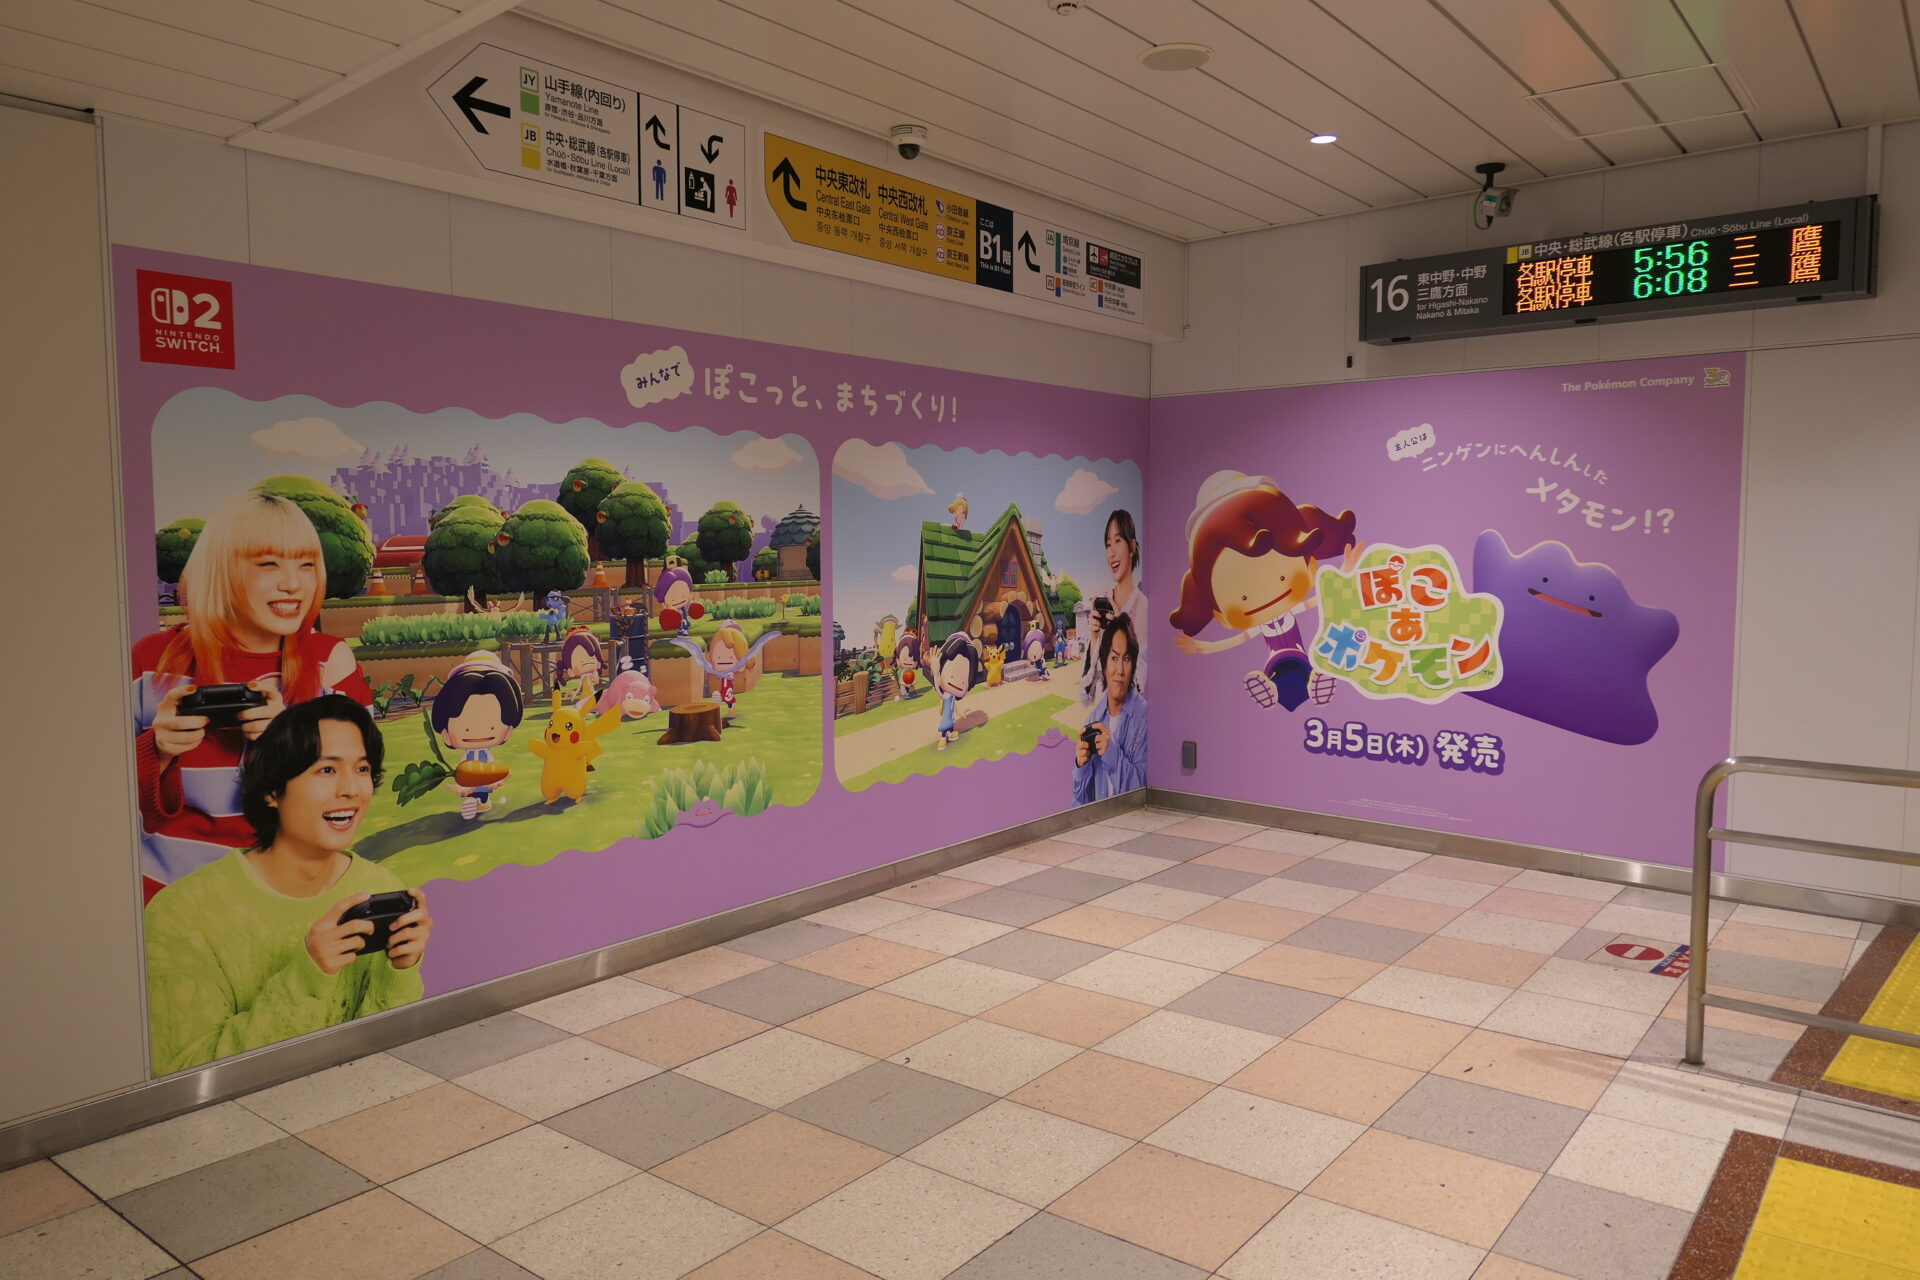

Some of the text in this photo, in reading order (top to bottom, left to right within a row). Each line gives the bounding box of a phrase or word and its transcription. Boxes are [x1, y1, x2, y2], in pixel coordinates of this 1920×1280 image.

[523, 73, 536, 86] JY
[545, 75, 626, 113] 山手線(内回り)
[545, 92, 599, 116] Yamanote Line
[524, 129, 537, 142] JB
[591, 158, 606, 170] Line
[608, 161, 631, 177] (Local)
[816, 164, 870, 199] 中央東改札
[816, 189, 871, 215] Central East Gate
[878, 184, 928, 216] 中央西改札
[879, 207, 929, 231] Central West Gate
[980, 217, 994, 229] ここは
[1750, 217, 1772, 232] Line
[1774, 213, 1809, 229] (Local)
[1534, 222, 1688, 257] 中央・総武線(各駅停車)
[1516, 254, 1595, 288] 各駅停車
[1633, 240, 1710, 274] 5:56
[1520, 247, 1530, 257] JB
[980, 261, 989, 269] This
[1001, 267, 1011, 275] Floor
[1416, 264, 1488, 287] 東中野・中野
[1369, 274, 1410, 314] 16
[1416, 283, 1469, 302] 三鷹方面
[1516, 280, 1594, 314] 各駅停車
[1632, 267, 1709, 300] 6:08
[192, 293, 222, 330] 2
[1416, 297, 1488, 312] for Higashi-Nakano
[1416, 306, 1480, 321] Nakano & Mitaka
[155, 328, 220, 342] NINTENDO
[155, 336, 221, 354] SWITCH
[635, 361, 683, 390] みんなで
[1561, 374, 1696, 393] The Pokémon Company
[1393, 432, 1428, 453] 主人公は
[1422, 442, 1609, 486] ニンゲンにへんしんした
[1359, 554, 1449, 608] ぽこ
[1389, 607, 1424, 643] あ
[1317, 624, 1491, 687] ポケモン
[1305, 718, 1501, 769] 3月5日(木) 発売
